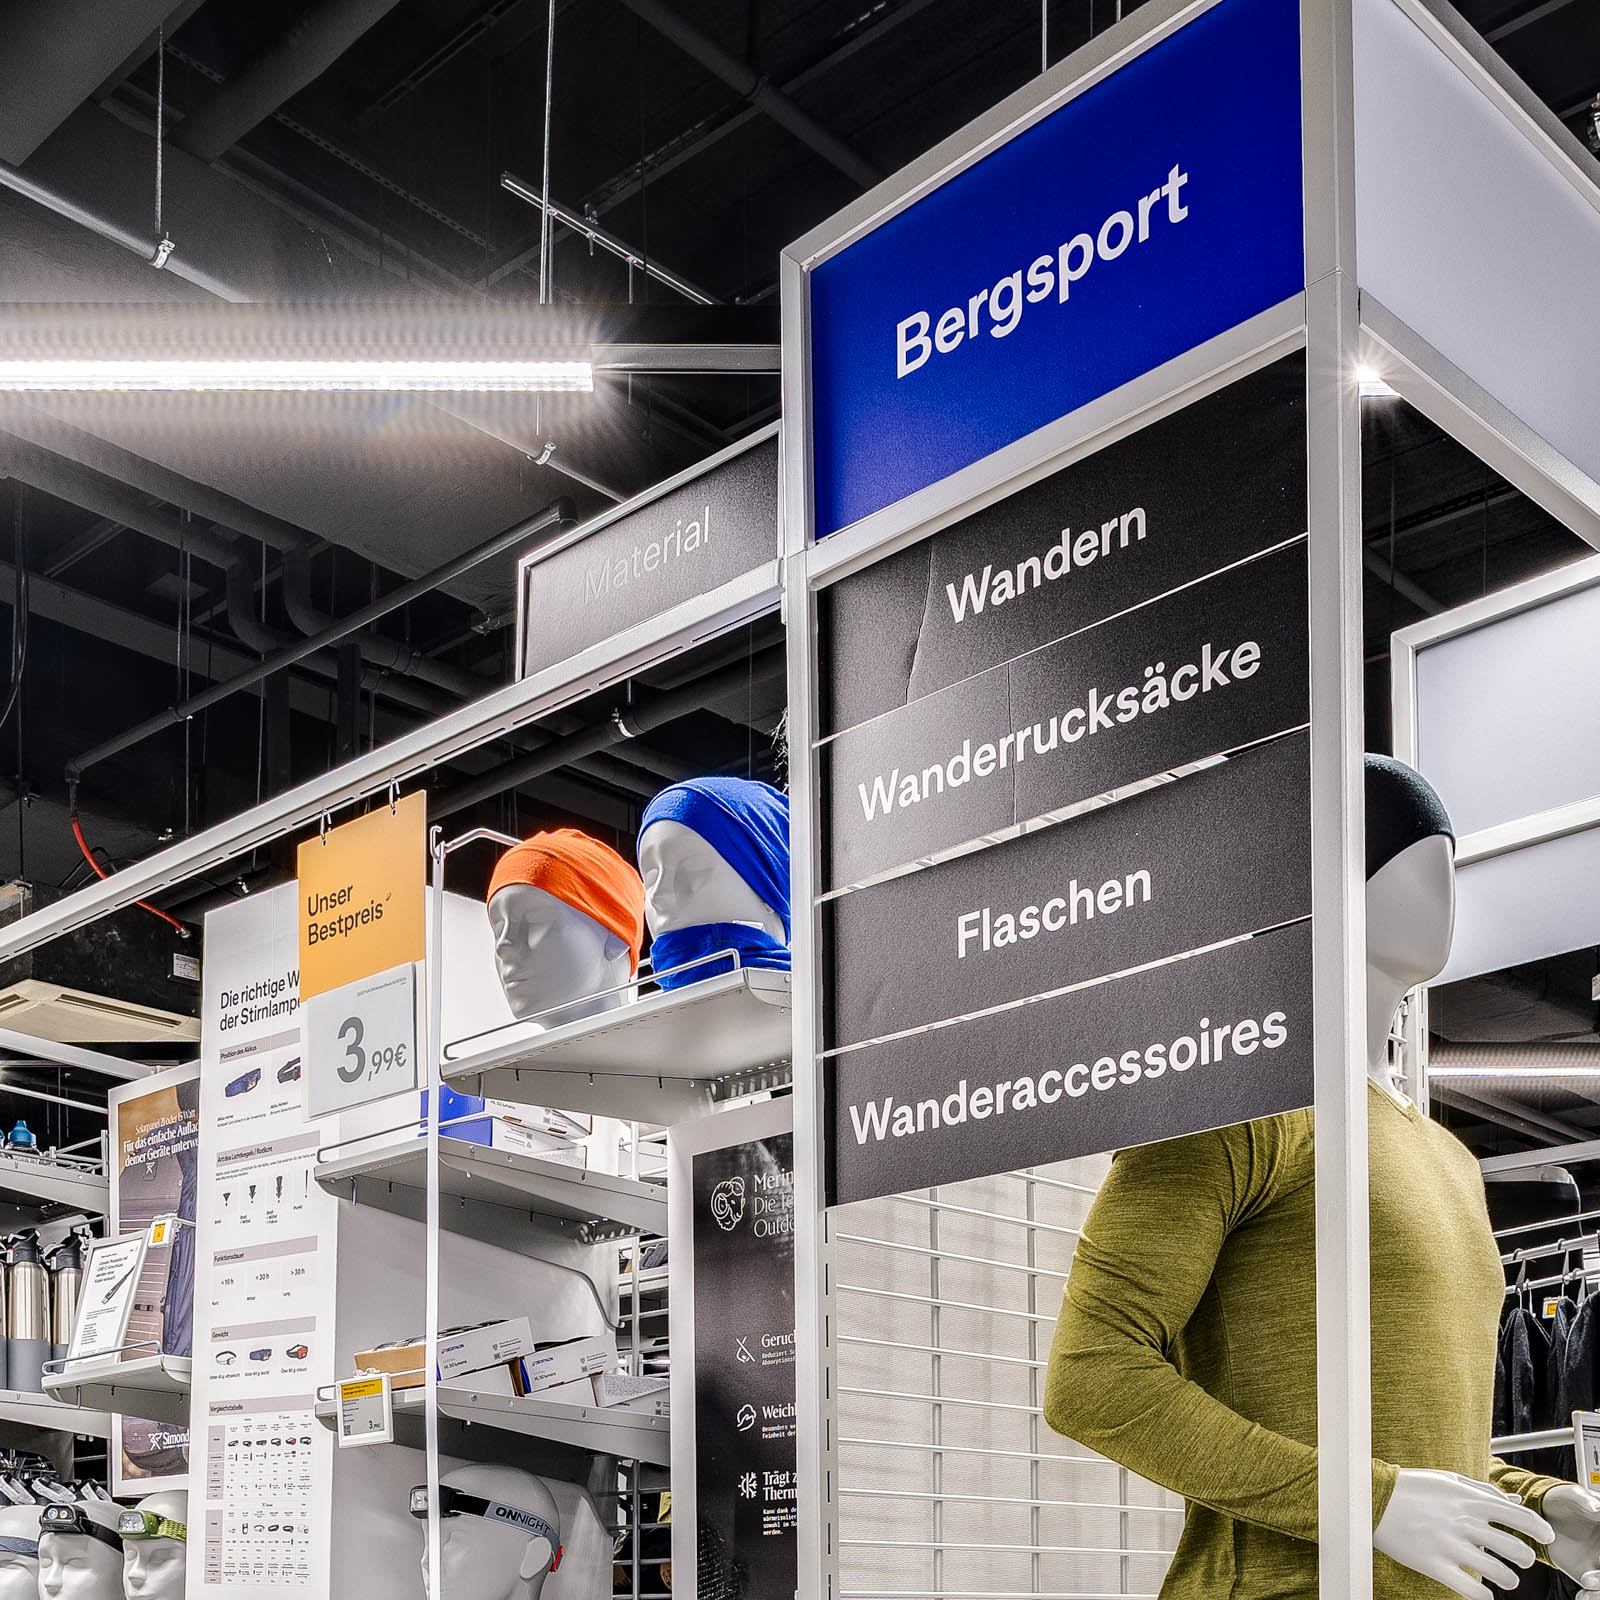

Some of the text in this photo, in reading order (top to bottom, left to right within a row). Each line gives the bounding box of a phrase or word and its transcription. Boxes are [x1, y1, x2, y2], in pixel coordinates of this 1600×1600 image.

[895, 163, 1189, 378] Bergsport
[582, 506, 710, 604] Material
[946, 507, 1148, 623] Wandern
[857, 640, 1262, 822] Wanderrucksäcke
[307, 885, 353, 916] Unser
[956, 865, 1153, 959] Flaschen
[308, 902, 383, 946] Bestpreis
[220, 970, 299, 1009] Die richtige W
[220, 1013, 239, 1031] der
[336, 1016, 407, 1083] 3,99€
[849, 1009, 1289, 1146] Wanderaccessoires
[754, 1195, 777, 1216] Die
[761, 1332, 795, 1348] Geruc
[761, 1402, 796, 1420] Weich
[762, 1471, 790, 1488] Trägt
